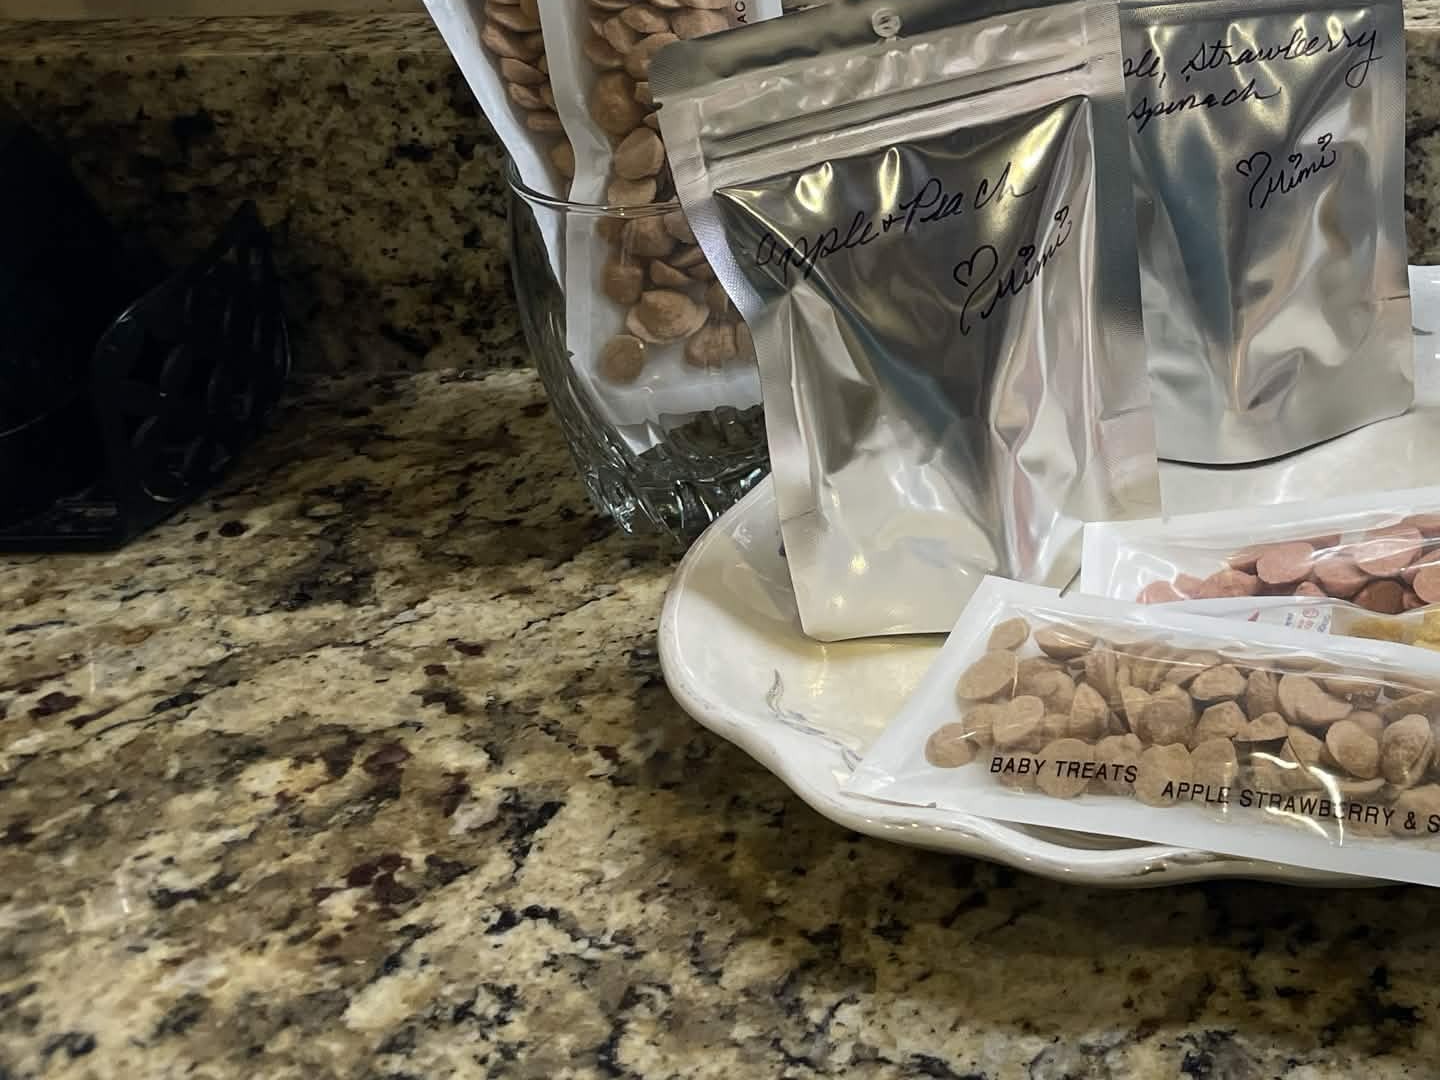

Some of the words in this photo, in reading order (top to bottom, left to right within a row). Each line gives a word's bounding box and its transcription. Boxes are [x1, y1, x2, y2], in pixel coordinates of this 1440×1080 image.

[990, 756, 1046, 776] BABY
[1055, 760, 1138, 784] TREATS
[1161, 781, 1231, 804] APPLE
[1403, 811, 1418, 831] &
